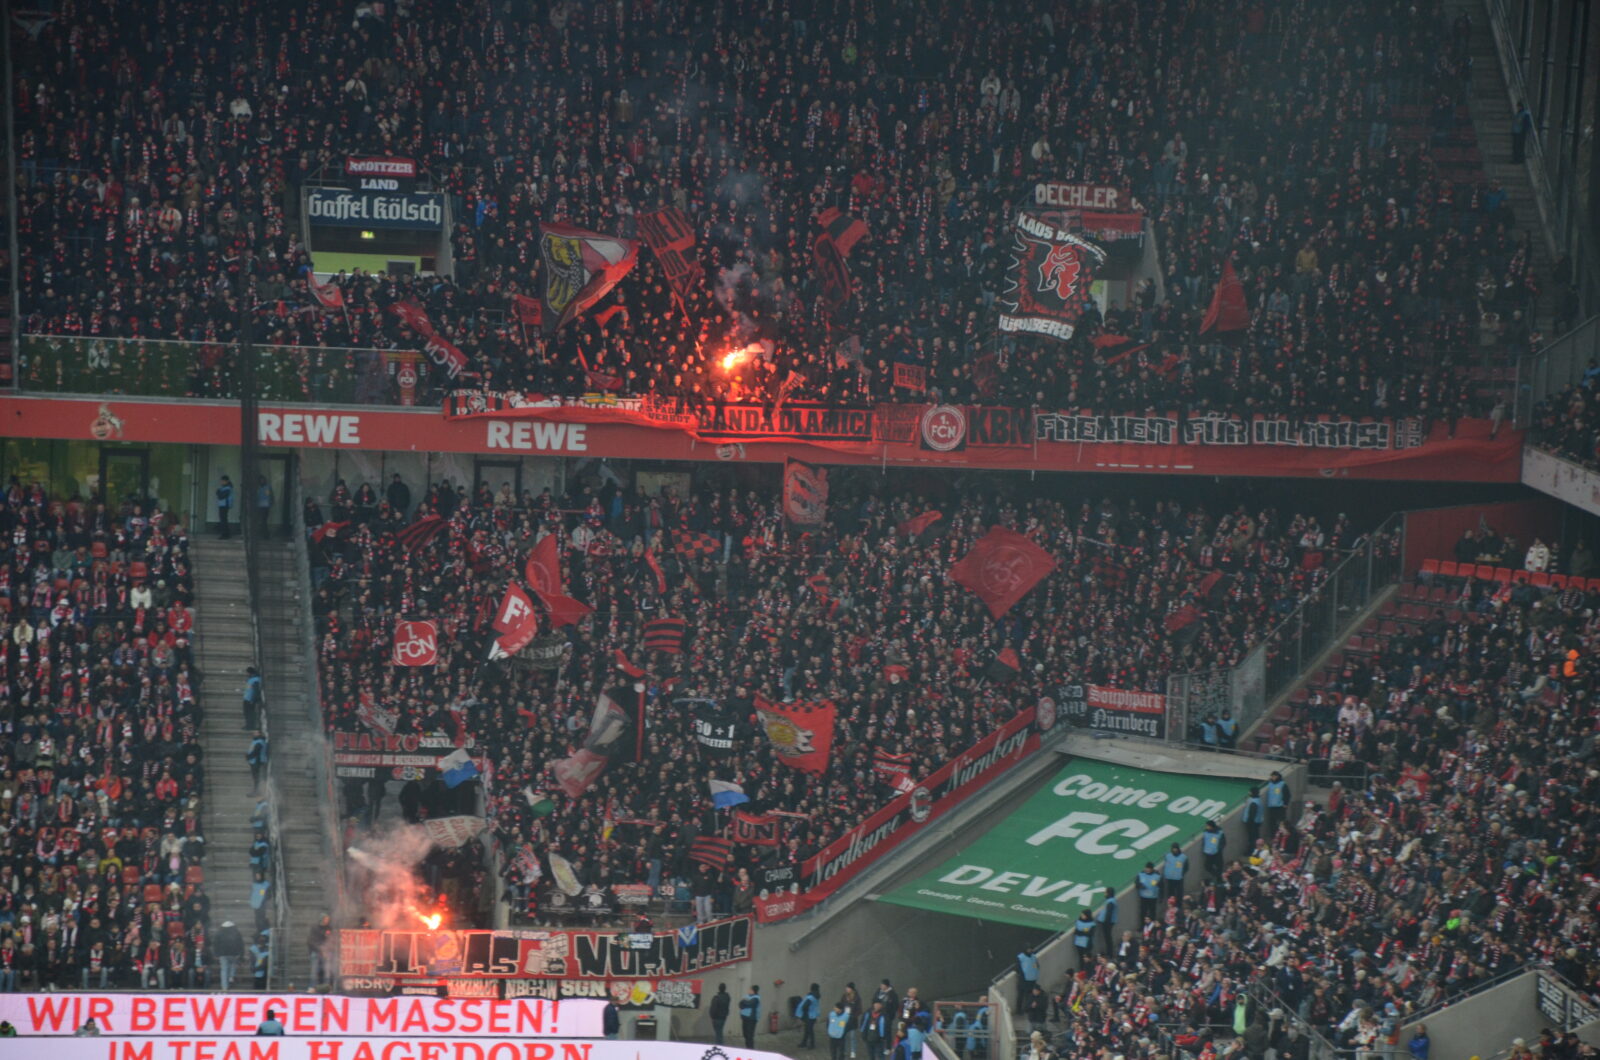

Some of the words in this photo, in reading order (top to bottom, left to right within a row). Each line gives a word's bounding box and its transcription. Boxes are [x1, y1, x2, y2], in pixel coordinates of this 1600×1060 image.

[360, 178, 399, 190] LAND
[1035, 183, 1118, 208] OECHLER
[308, 194, 370, 220] Gaffel
[373, 196, 442, 224] Kölsch
[1017, 212, 1054, 240] KAOS
[258, 414, 360, 444] REWE
[487, 420, 587, 450] REWE
[931, 425, 957, 438] FCN
[969, 408, 1032, 445] KBN
[1184, 411, 1249, 445] FÜR
[404, 624, 418, 640] 1.
[396, 635, 435, 661] FCN
[513, 645, 563, 660] IASKO
[694, 719, 713, 736] 50
[1090, 708, 1158, 737] Nürnberg
[942, 728, 1028, 796] Nürnberg
[1052, 774, 1170, 809] Come
[738, 819, 774, 840] UN
[1024, 810, 1181, 860] FC!
[809, 814, 901, 890] Nordkurve
[764, 867, 794, 883] CHAMPS
[938, 864, 1108, 907] DEVK
[376, 932, 519, 975] ULAS
[561, 980, 606, 997] SGN
[26, 998, 114, 1031] WIR
[129, 998, 350, 1033] BEWEGEN
[365, 999, 560, 1034] MASSEN!
[109, 1041, 154, 1060] IM
[170, 1041, 280, 1060] TEAM
[307, 1041, 593, 1060] HAGEDORN
